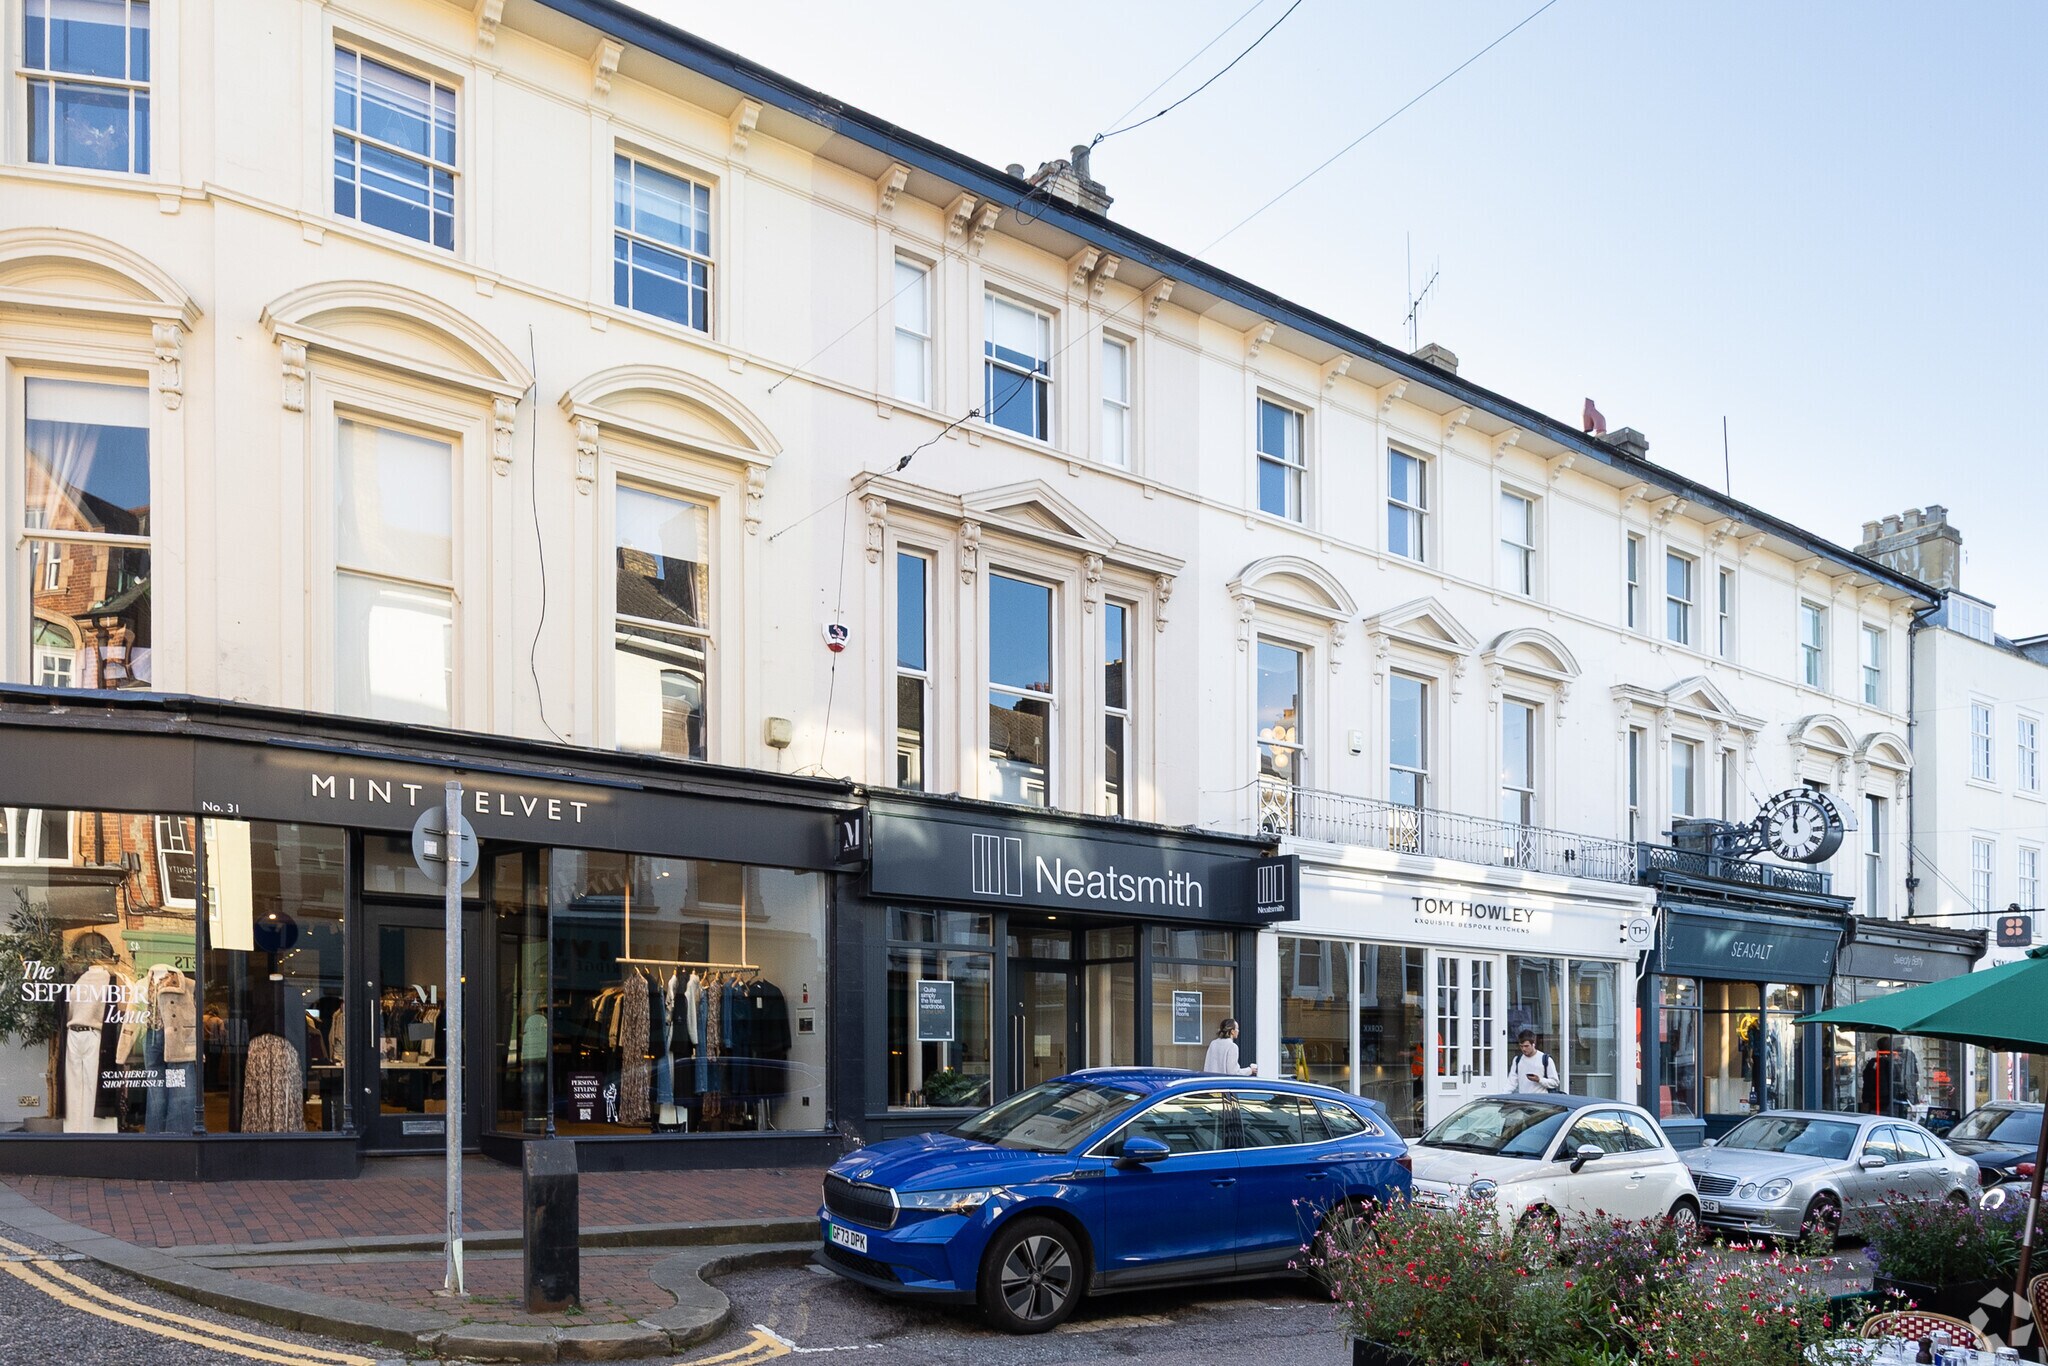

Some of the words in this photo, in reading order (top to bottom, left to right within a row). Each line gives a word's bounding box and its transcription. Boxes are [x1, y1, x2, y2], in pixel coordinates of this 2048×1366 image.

[202, 801, 225, 813] No.
[227, 803, 240, 814] 31
[311, 773, 422, 806] MINT
[460, 790, 588, 823] ELVET
[1035, 855, 1203, 908] Neatsmith
[1257, 905, 1285, 914] Neatsmith
[1411, 896, 1453, 915] TOM
[1461, 902, 1535, 923] HOWLEY
[1414, 918, 1455, 927] EXQUISITE
[1458, 922, 1492, 931] BESPOKE
[1495, 926, 1530, 934] KITCHENS
[1632, 926, 1648, 935] TH
[1731, 941, 1773, 960] SEASALT
[22, 960, 55, 980] The
[21, 982, 150, 1004] SEPTEMBER
[104, 1005, 151, 1024] Issue
[102, 1070, 124, 1079] SCAN
[124, 1070, 146, 1078] HERE
[145, 1070, 158, 1078] TO
[102, 1080, 125, 1089] SHOP
[125, 1080, 141, 1088] THE
[141, 1080, 164, 1088] ISSUE
[1700, 1201, 1715, 1211] SG
[832, 1225, 850, 1244] GF73
[850, 1231, 866, 1250] DPK
